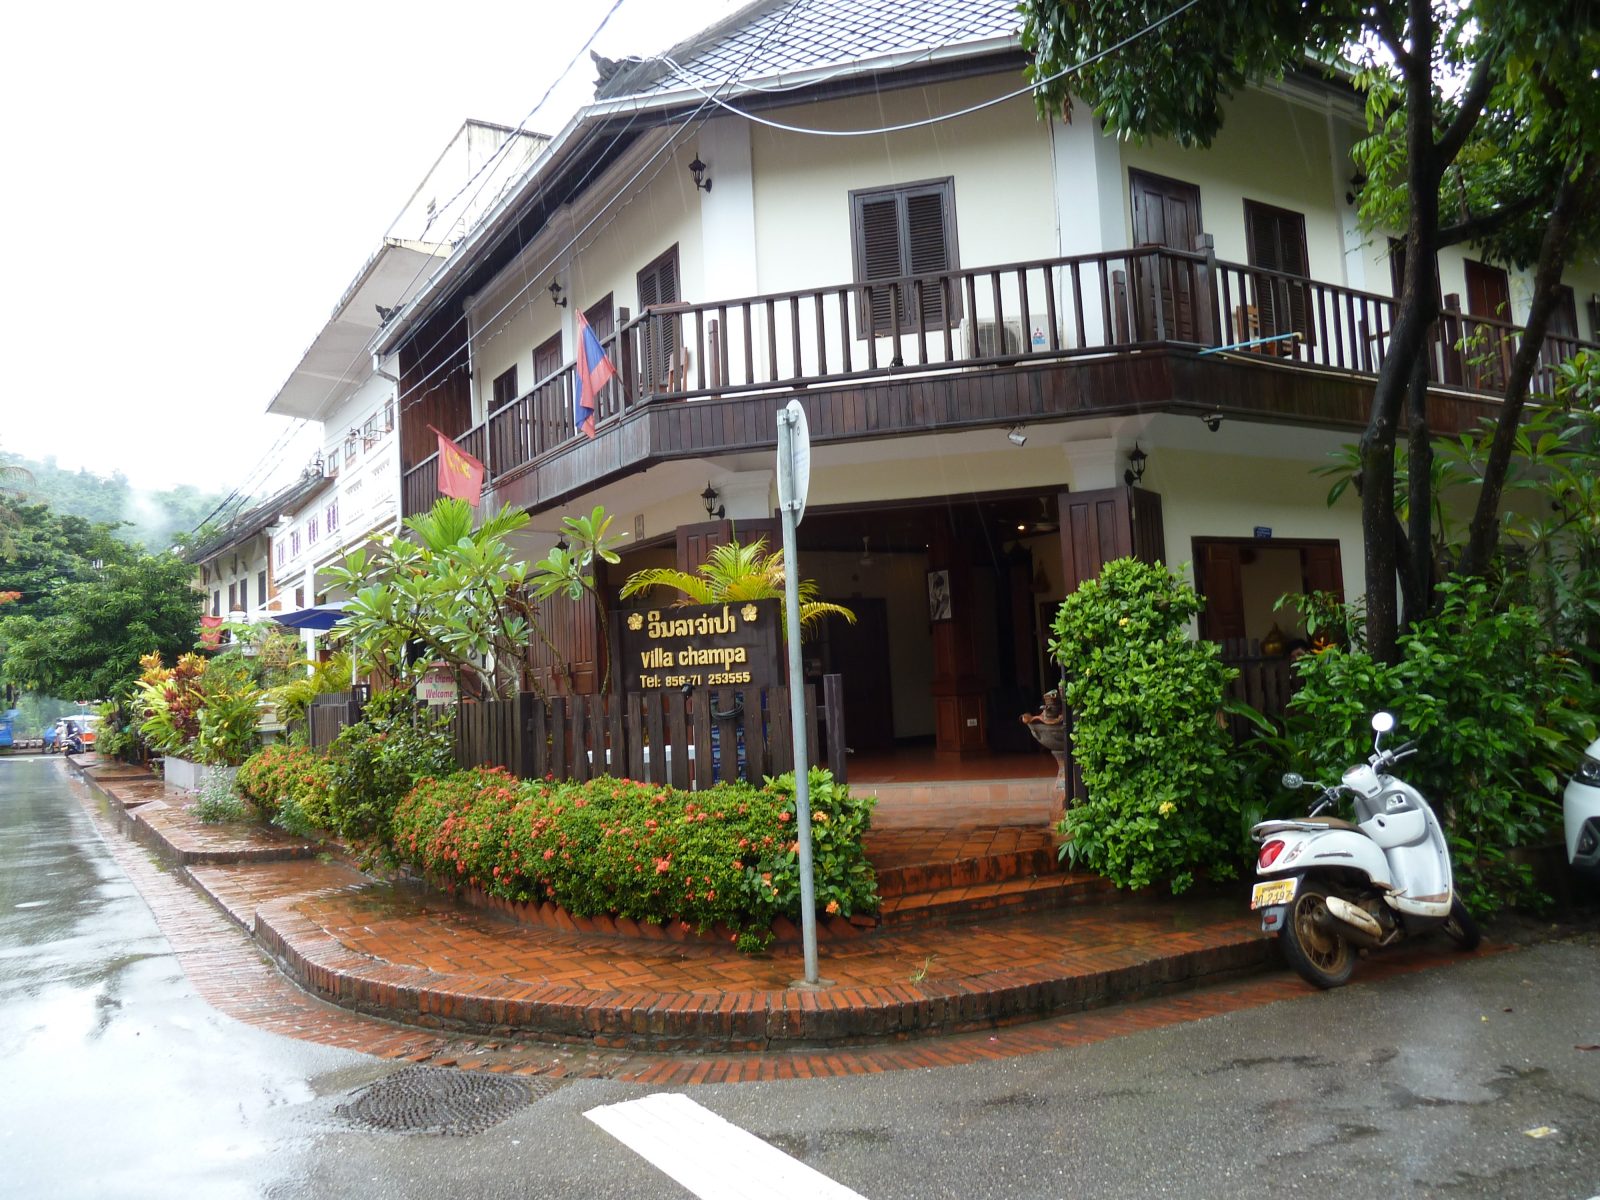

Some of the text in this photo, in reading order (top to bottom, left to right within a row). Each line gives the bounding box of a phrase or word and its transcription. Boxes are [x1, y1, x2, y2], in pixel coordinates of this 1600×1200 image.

[678, 646, 746, 671] champa
[640, 671, 751, 688] Tel: 856-71 253555
[425, 689, 454, 699] Welcome
